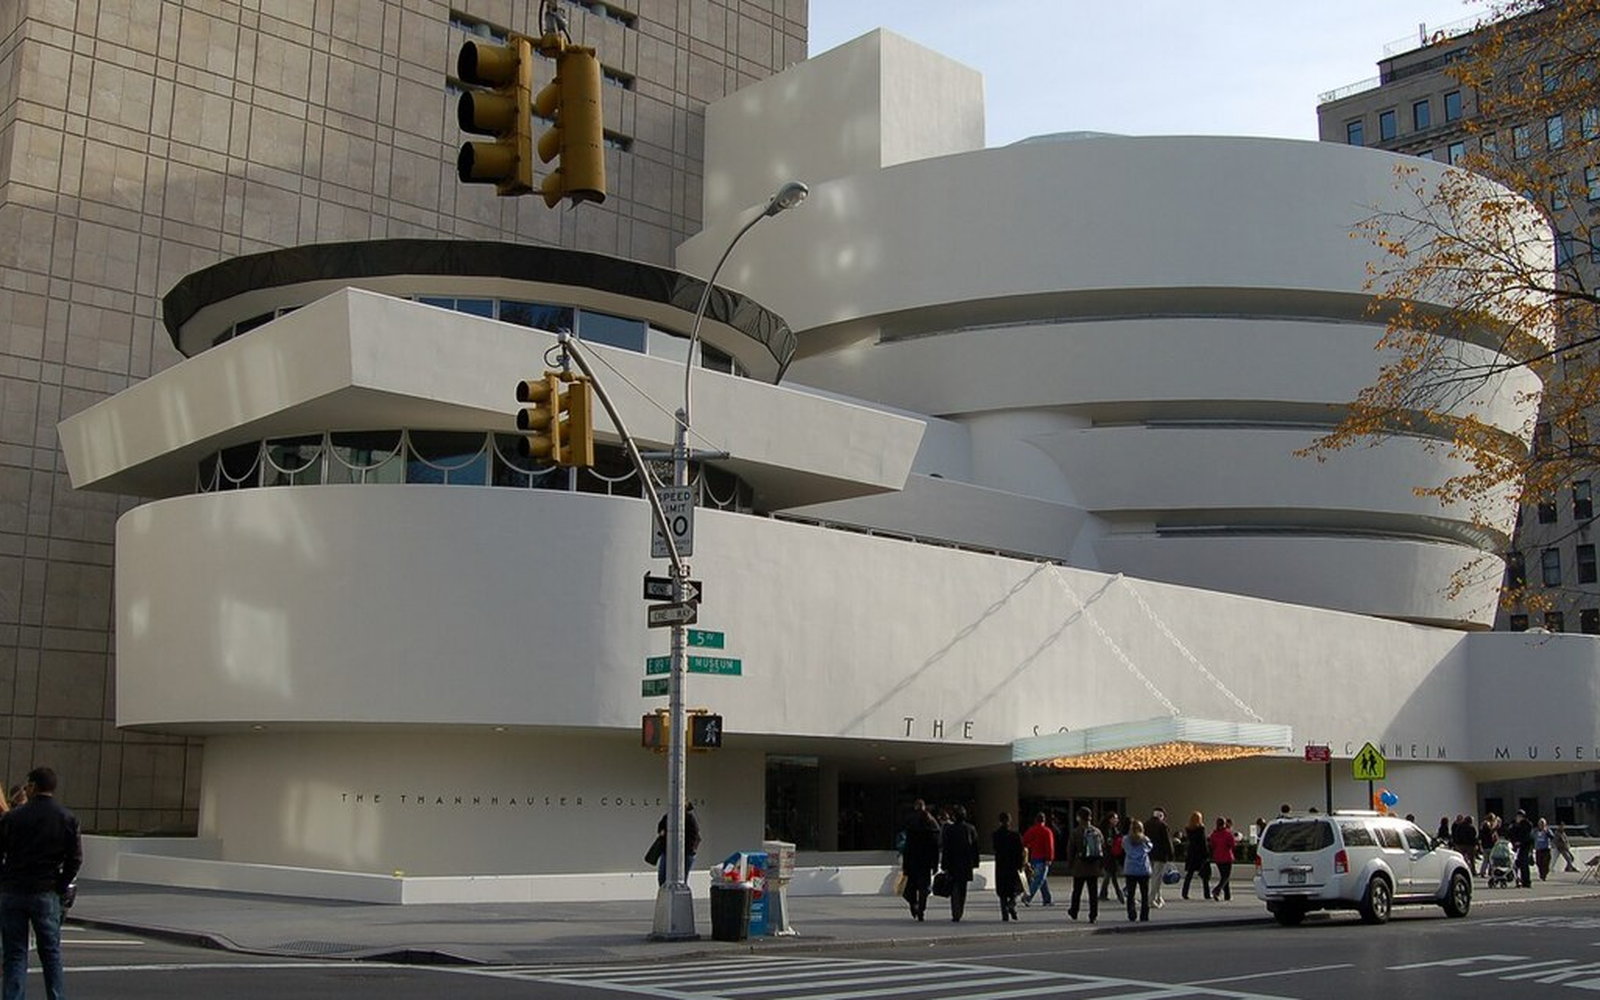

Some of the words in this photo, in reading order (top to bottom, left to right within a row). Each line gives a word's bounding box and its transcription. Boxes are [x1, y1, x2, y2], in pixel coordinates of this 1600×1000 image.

[697, 632, 705, 646] 5
[695, 658, 734, 669] MUSEUM
[904, 717, 974, 739] THE
[341, 793, 381, 803] THE
[401, 795, 583, 806] THANNHAUSER
